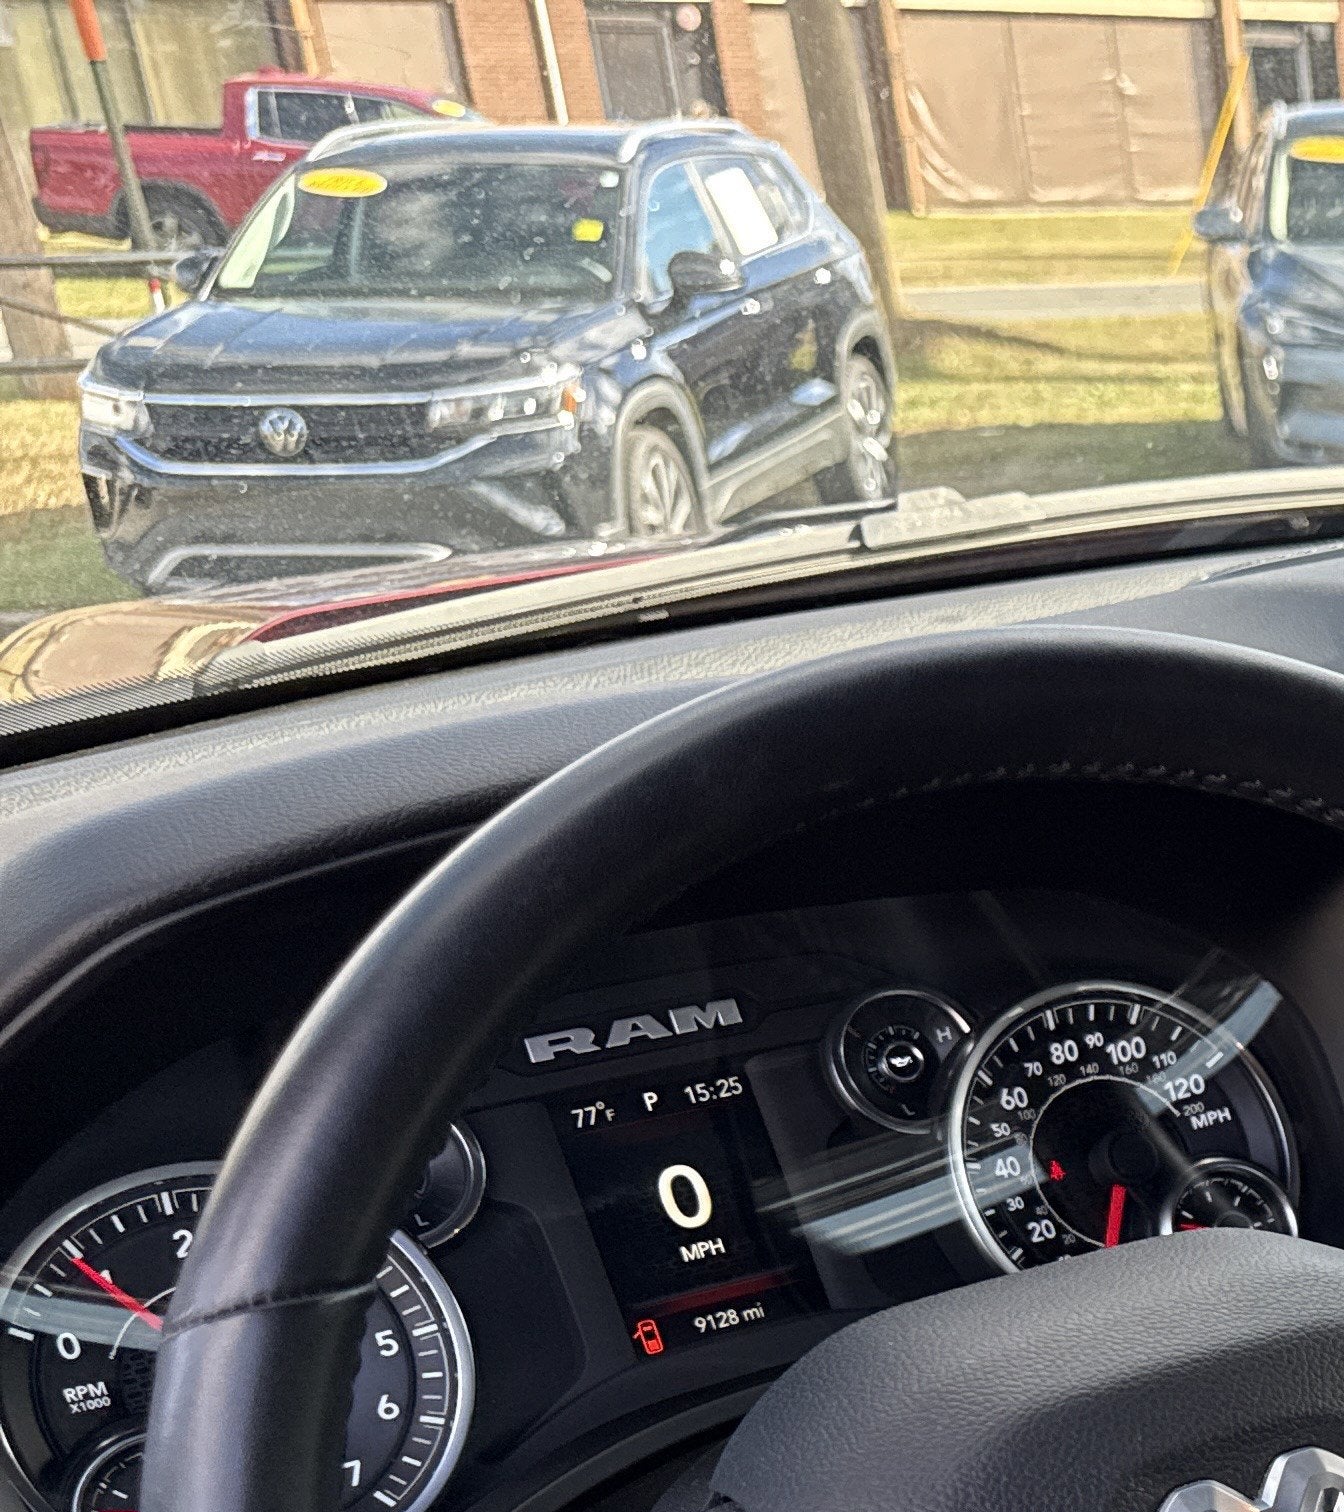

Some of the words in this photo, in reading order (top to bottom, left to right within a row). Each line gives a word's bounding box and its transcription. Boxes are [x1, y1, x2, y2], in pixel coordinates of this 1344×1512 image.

[524, 998, 743, 1064] RAM
[936, 1026, 953, 1043] H
[1084, 1032, 1104, 1049] 90
[1049, 1039, 1079, 1065] 80
[1106, 1036, 1147, 1065] 100
[1152, 1051, 1177, 1069] 110
[1023, 1061, 1043, 1078] 70
[1048, 1073, 1067, 1087] 120
[1079, 1062, 1100, 1076] 140
[1119, 1062, 1140, 1075] 160
[643, 1091, 658, 1111] P
[684, 1076, 743, 1105] 15:25
[1000, 1086, 1029, 1111] 60
[1163, 1074, 1206, 1102] 120
[1017, 1108, 1037, 1121] 100
[1182, 1101, 1205, 1117] 200
[1189, 1107, 1232, 1130] MPH
[990, 1122, 1011, 1138] 50
[995, 1155, 1021, 1179] 40
[658, 1164, 713, 1230] 0
[1006, 1196, 1025, 1212] 30
[1027, 1218, 1057, 1243] 20
[172, 1229, 194, 1259] 2
[679, 1238, 726, 1263] MPH
[694, 1309, 740, 1334] 9128
[744, 1302, 766, 1321] mi
[56, 1332, 82, 1361] 0
[375, 1330, 399, 1357] 5
[62, 1381, 108, 1404] RPM
[68, 1395, 112, 1415] X1000
[377, 1394, 400, 1420] 6
[342, 1460, 362, 1487] 7
